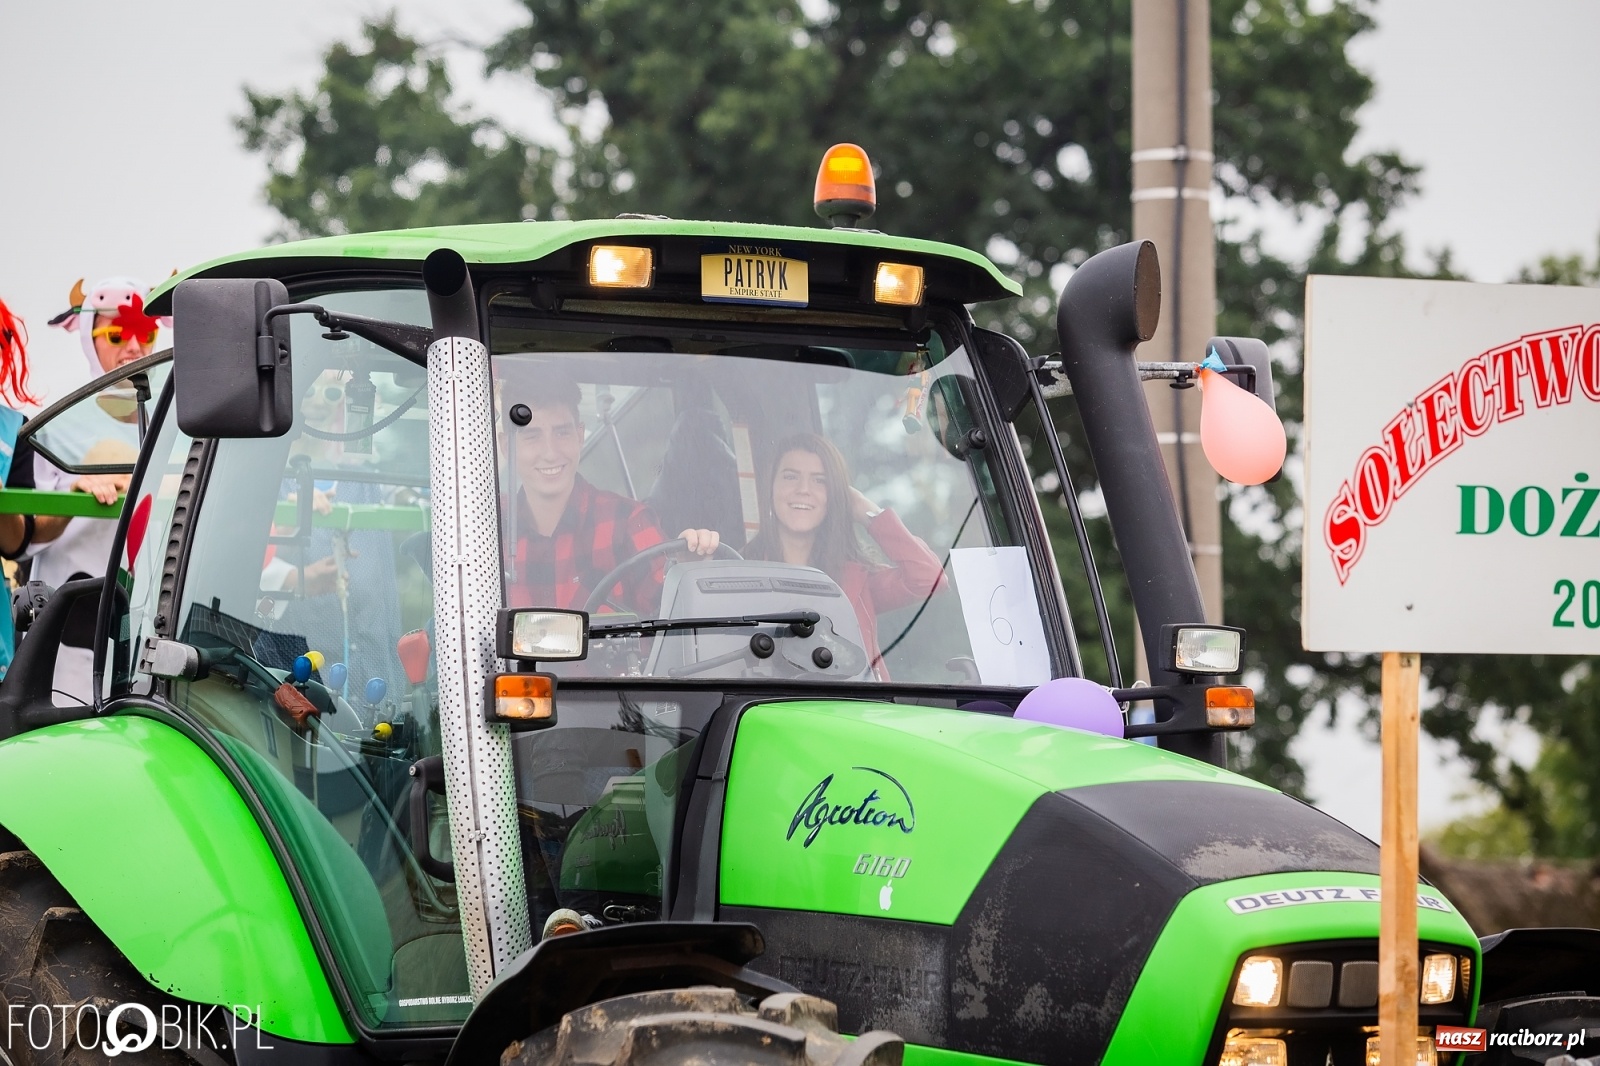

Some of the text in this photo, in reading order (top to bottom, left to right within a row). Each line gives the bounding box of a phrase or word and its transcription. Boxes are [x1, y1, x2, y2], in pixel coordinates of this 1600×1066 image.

[728, 244, 782, 257] NEW YORK
[724, 257, 788, 290] PATRYK
[729, 287, 782, 299] EMPIRE STATE
[1456, 472, 1600, 538] DOŻ
[1552, 579, 1600, 629] 20
[853, 853, 912, 879] 6160
[1234, 888, 1444, 910] DEUTZ FR
